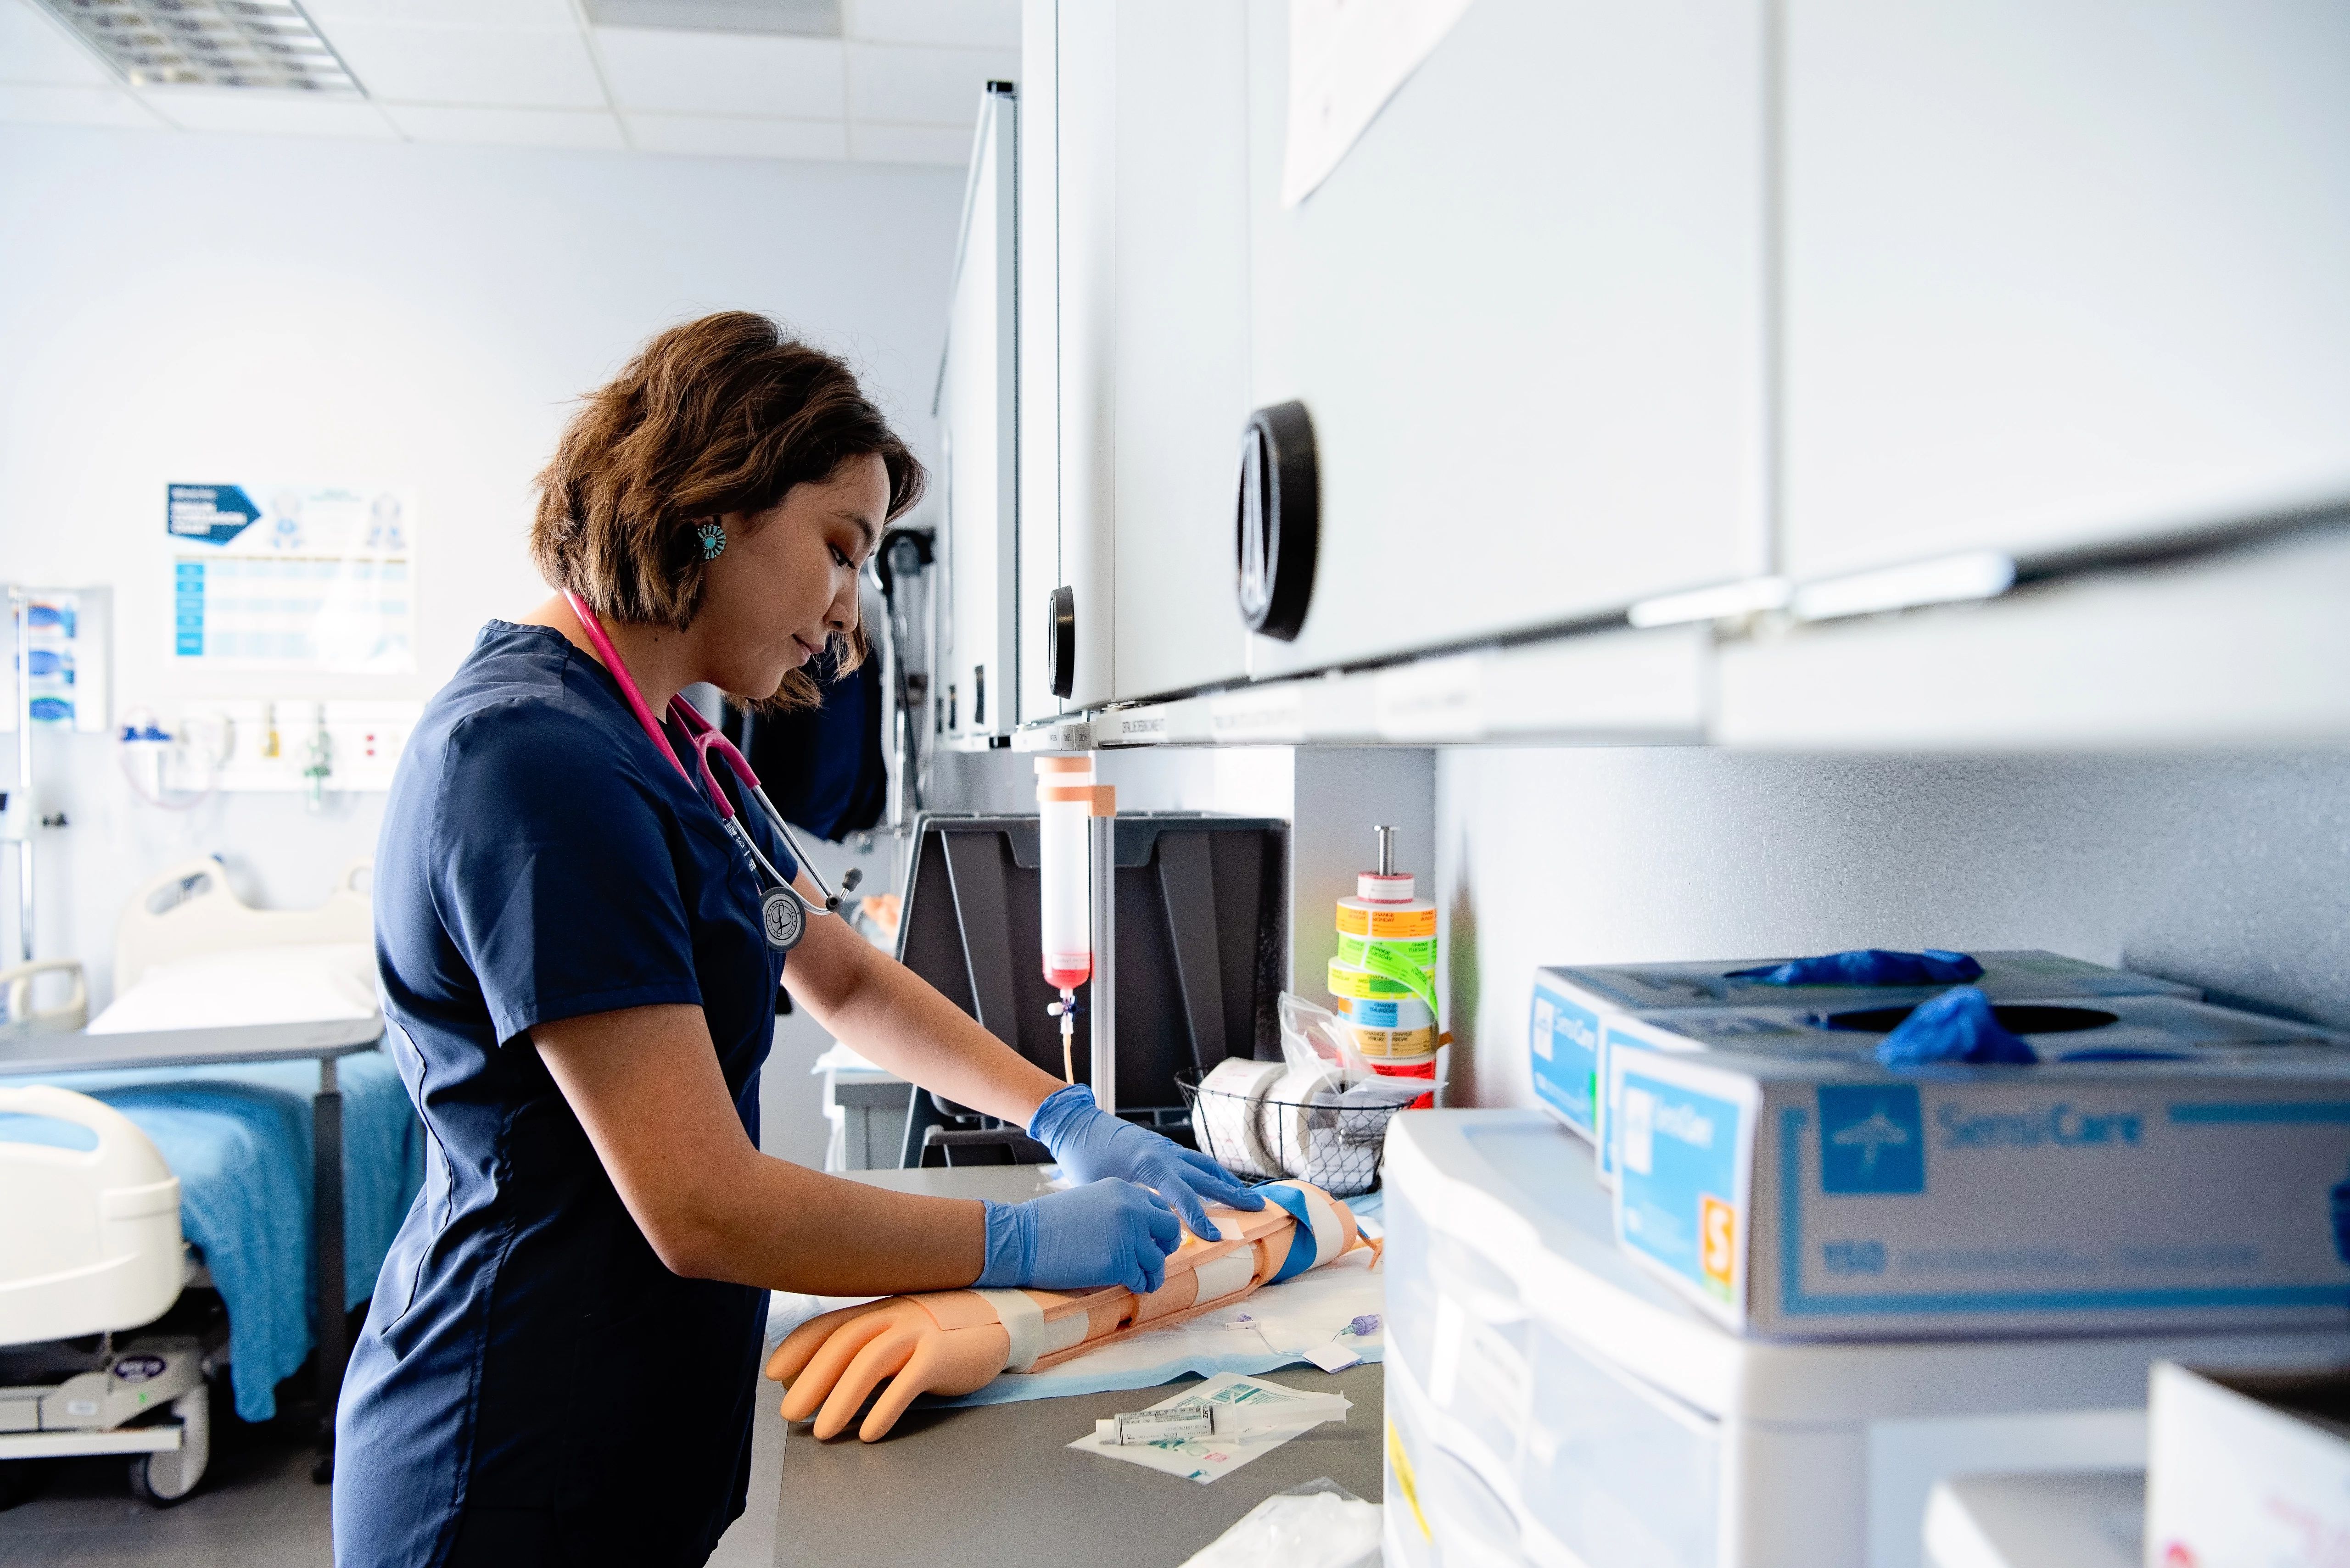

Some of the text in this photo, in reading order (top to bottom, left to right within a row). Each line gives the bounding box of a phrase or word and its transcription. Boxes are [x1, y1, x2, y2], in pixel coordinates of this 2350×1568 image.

[768, 902, 778, 935] LITTMANN
[788, 907, 797, 936] QUALITY
[1708, 1207, 1729, 1272] S
